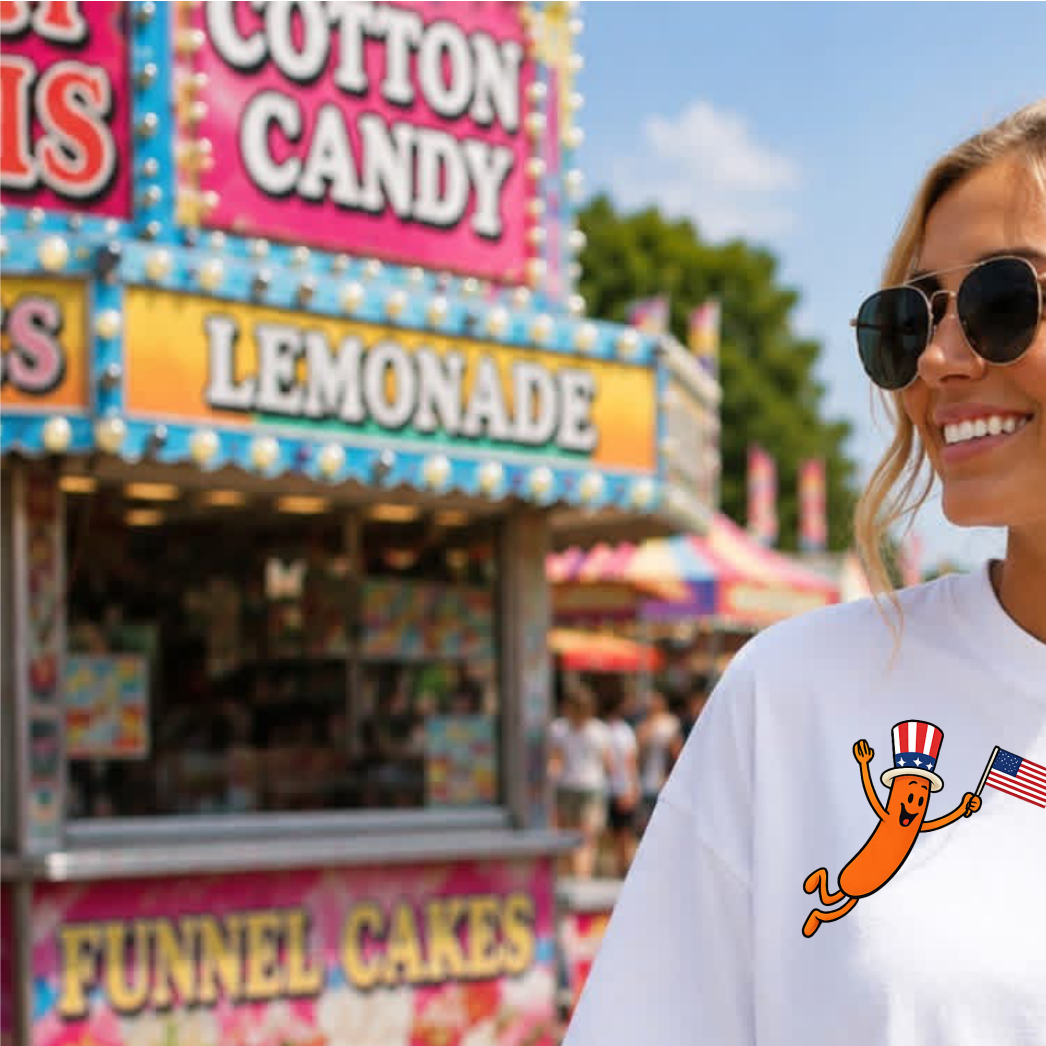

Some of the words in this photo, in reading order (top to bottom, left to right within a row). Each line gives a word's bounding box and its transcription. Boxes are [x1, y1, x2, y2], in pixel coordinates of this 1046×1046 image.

[205, 1, 522, 131] COTTON
[241, 91, 512, 238] CANDY
[0, 297, 62, 391] S
[206, 316, 598, 450] LEMONADE
[60, 909, 322, 1018] FUNNEL
[341, 893, 535, 989] CAKES
